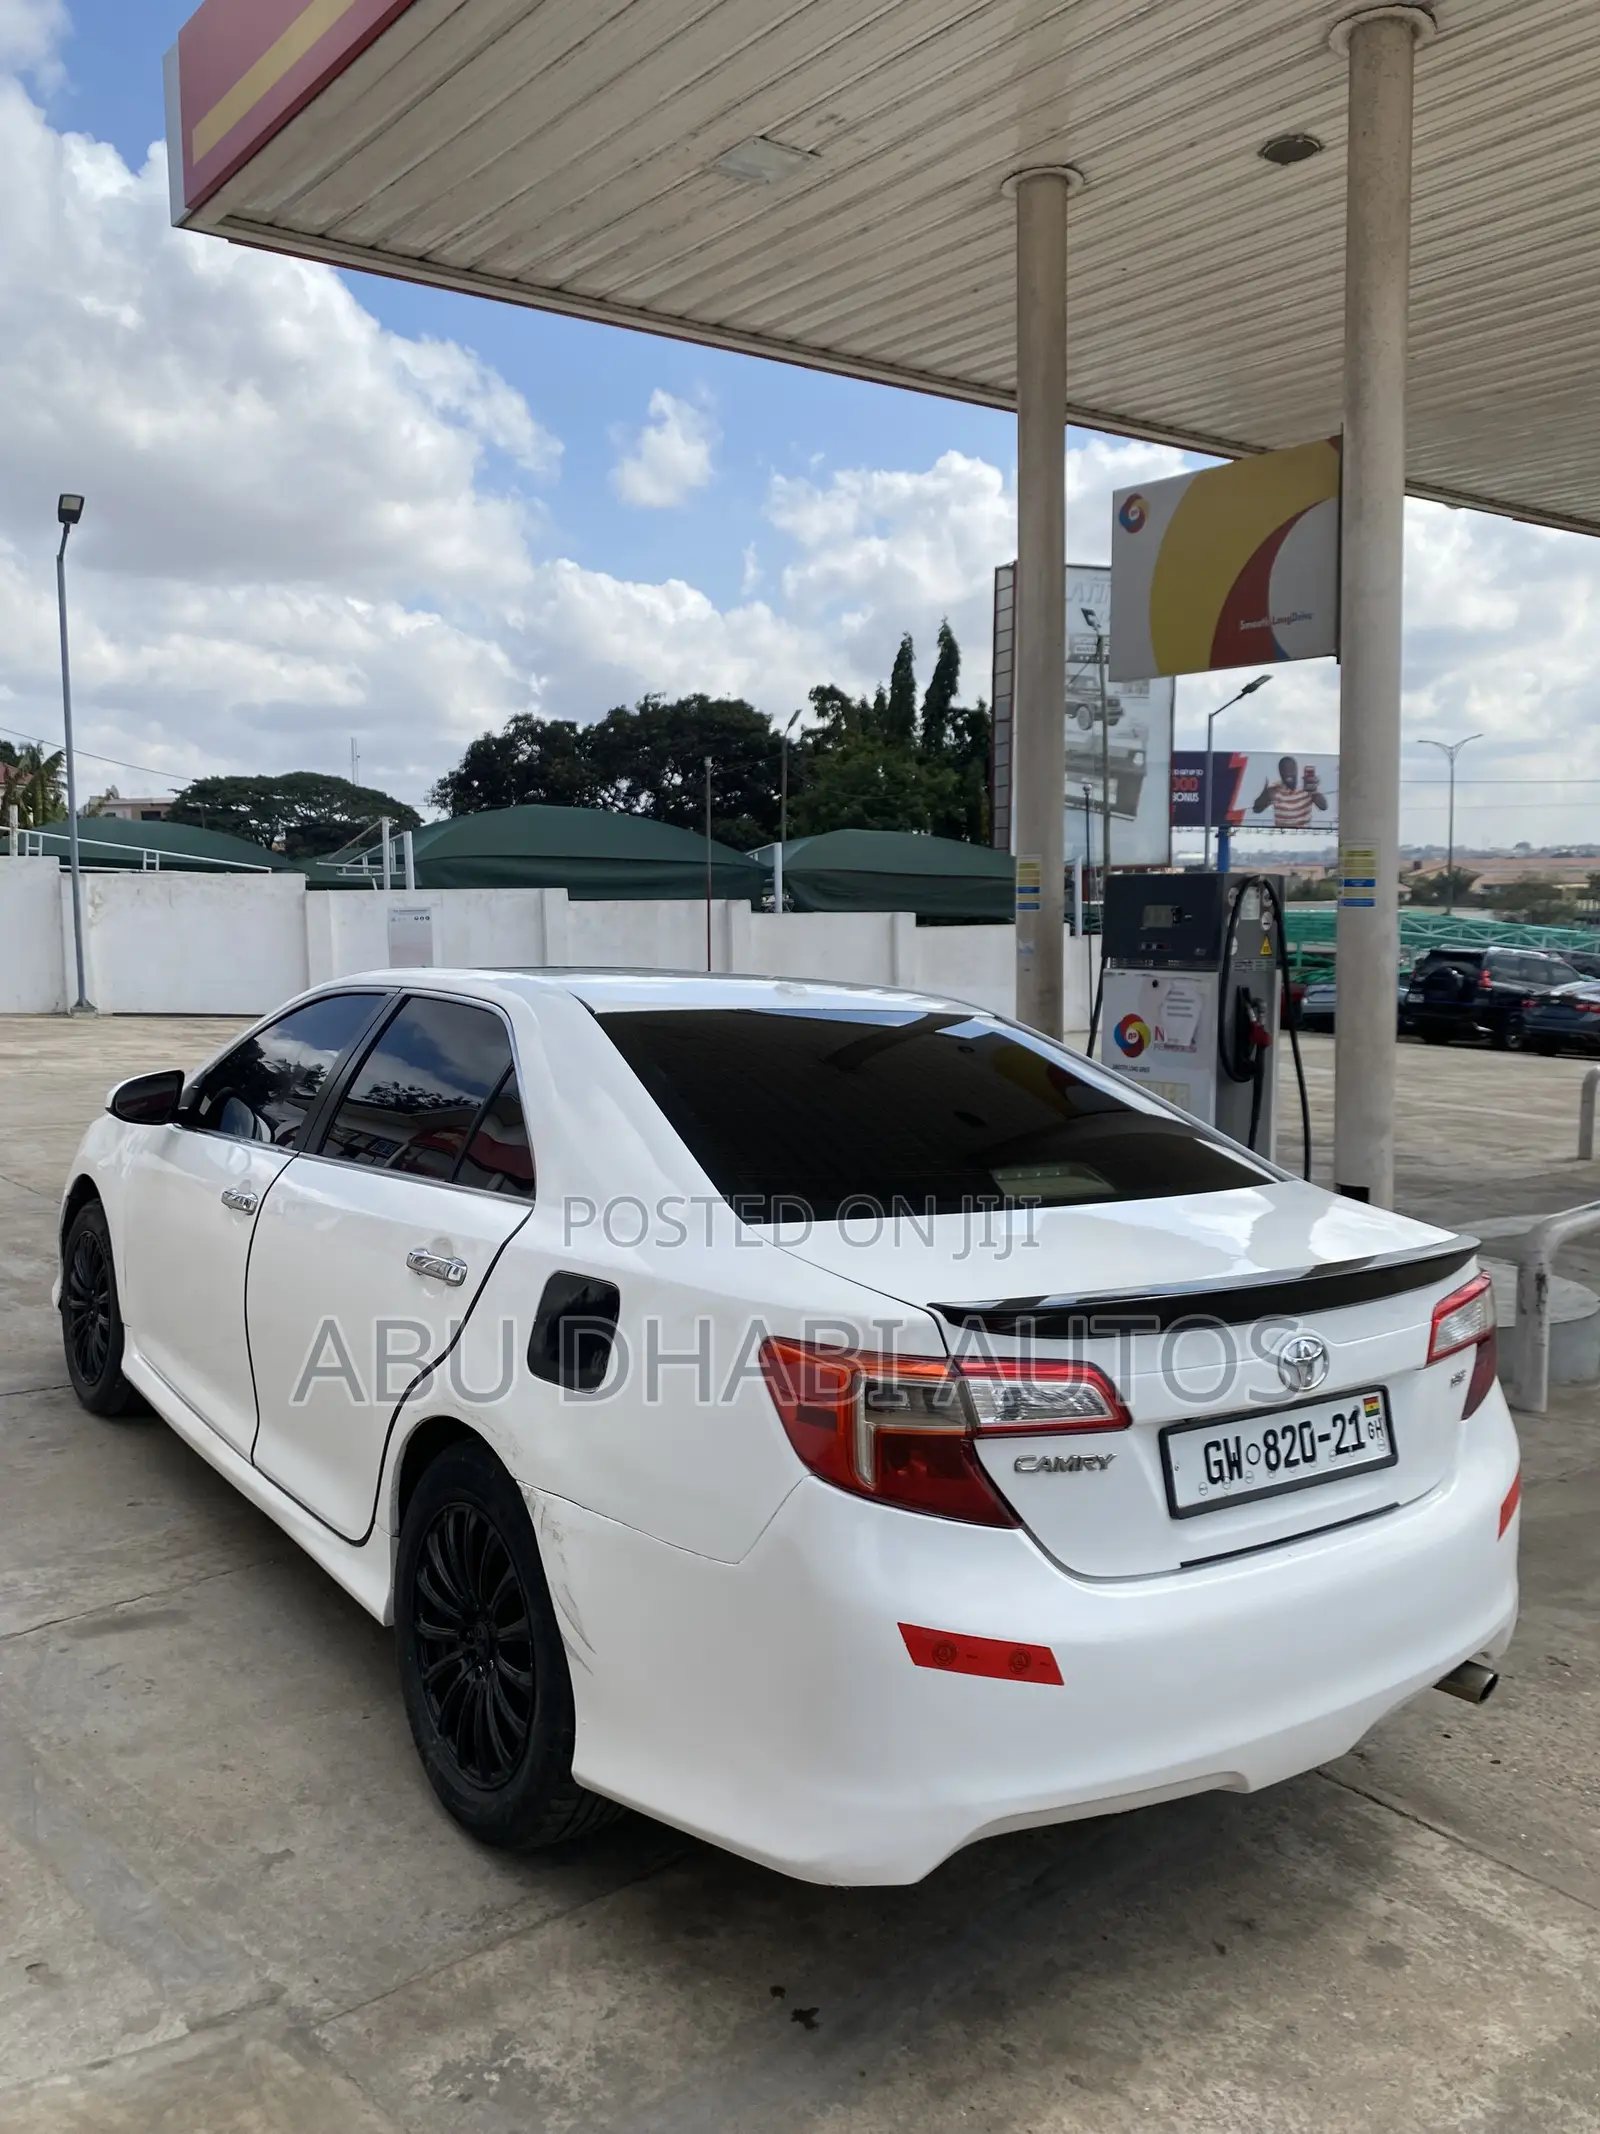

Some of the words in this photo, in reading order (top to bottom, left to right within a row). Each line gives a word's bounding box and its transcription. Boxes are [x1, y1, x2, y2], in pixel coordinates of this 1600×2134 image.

[1367, 1416, 1384, 1441] GH
[1204, 1436, 1244, 1485] GW
[1263, 1405, 1366, 1472] 820-21
[1014, 1452, 1118, 1473] CAMRY
